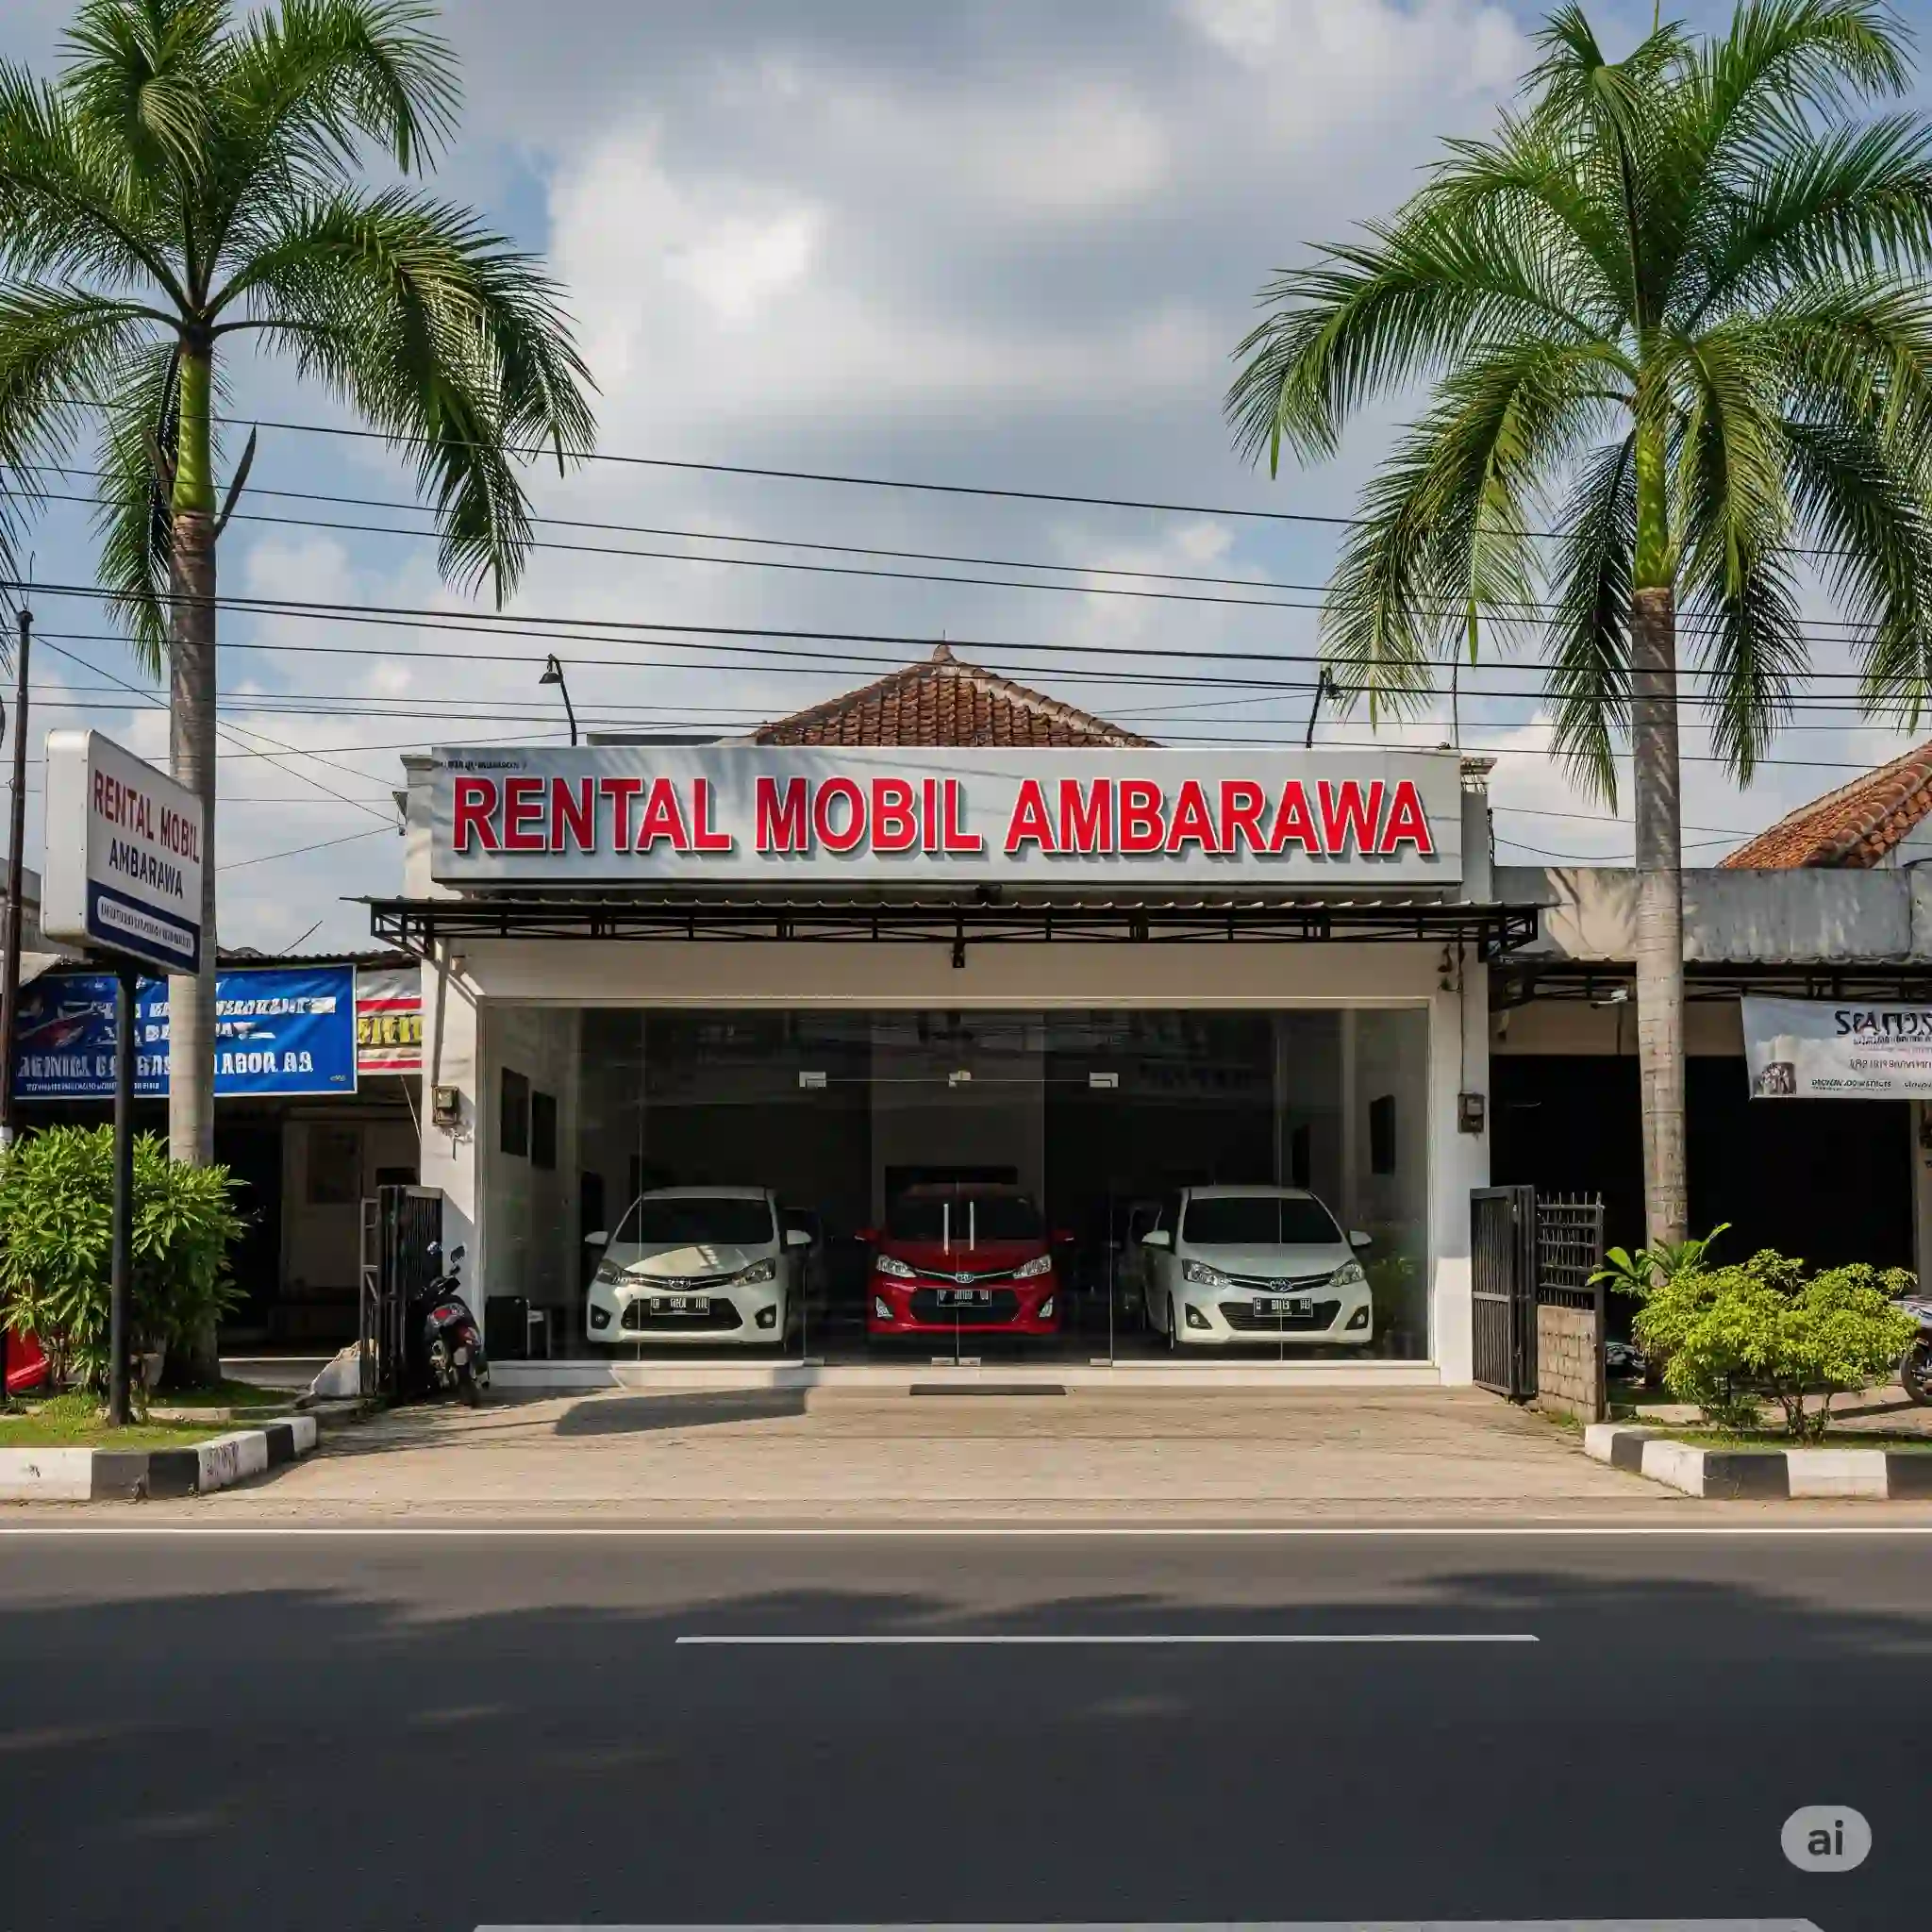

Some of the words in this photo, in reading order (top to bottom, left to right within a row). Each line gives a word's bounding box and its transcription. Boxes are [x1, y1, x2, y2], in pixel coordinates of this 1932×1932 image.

[93, 769, 154, 841] RENTAL
[160, 806, 200, 864] MOBIL
[452, 776, 732, 852] RENTAL
[756, 776, 982, 853] MOBIL
[1004, 778, 1434, 855] AMBARAWA
[108, 838, 184, 899] AMBARAWA
